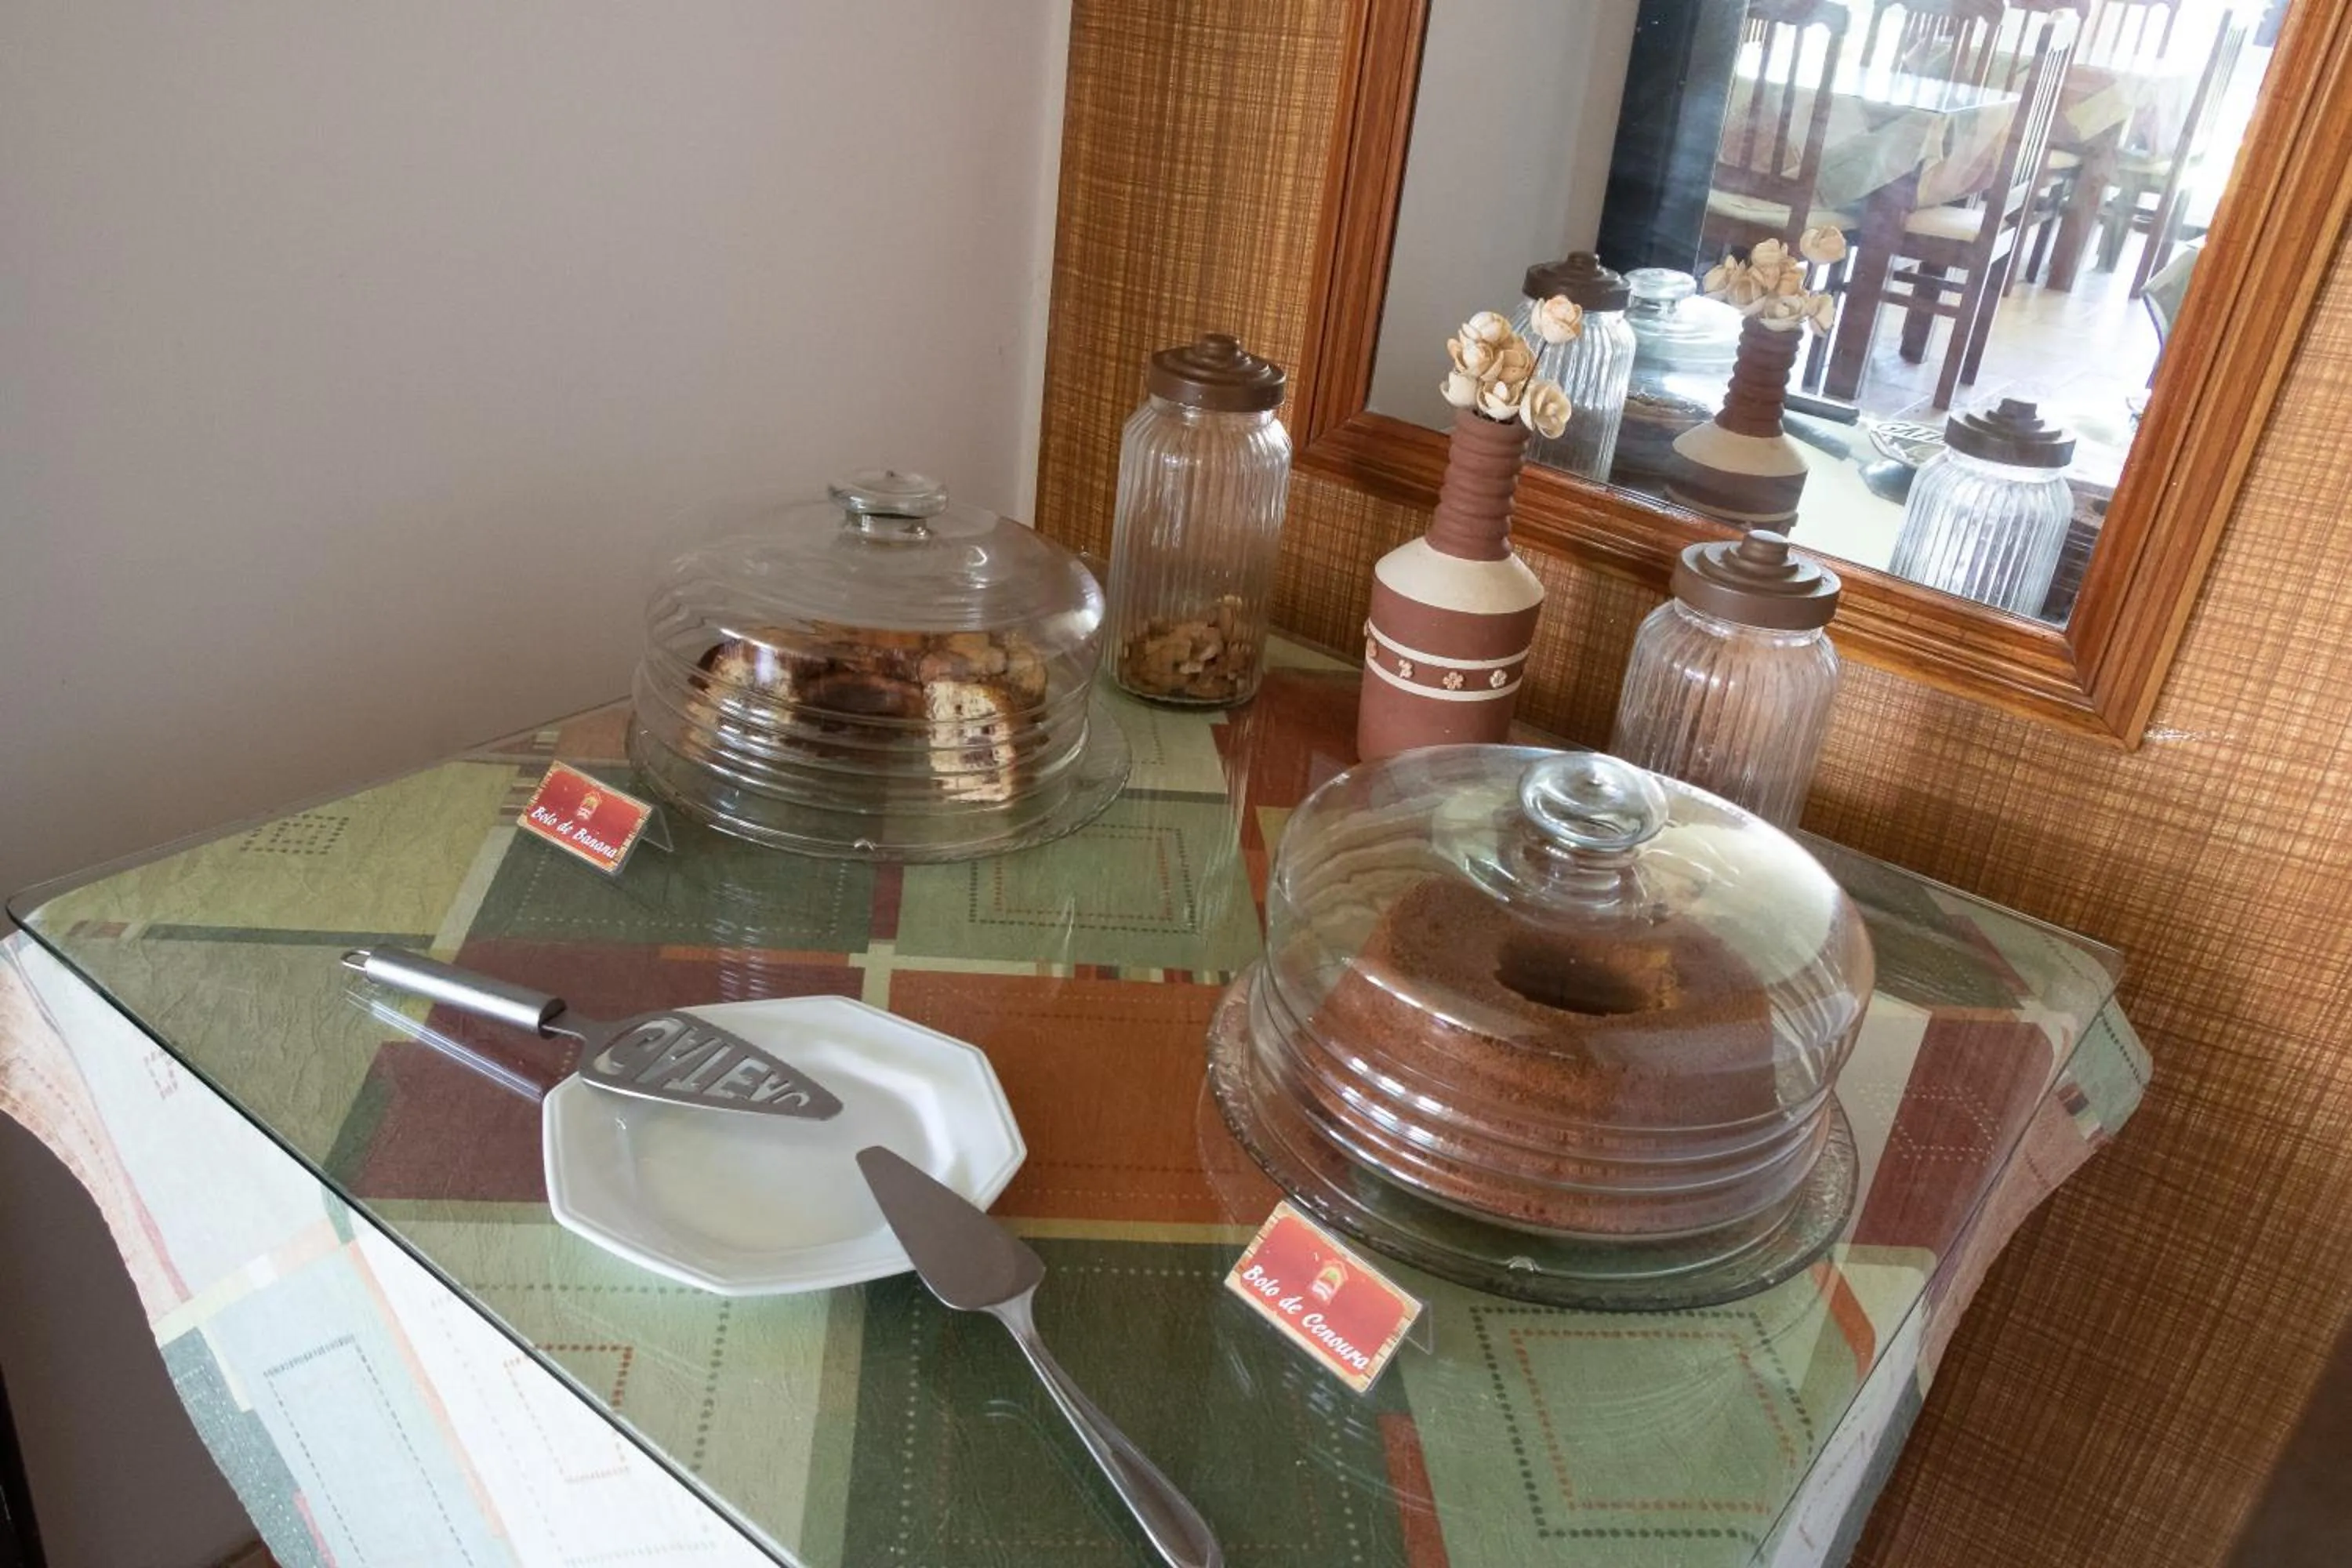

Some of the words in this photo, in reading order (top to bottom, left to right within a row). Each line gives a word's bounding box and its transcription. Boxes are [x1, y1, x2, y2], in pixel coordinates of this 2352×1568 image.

[531, 806, 557, 826] Bolo
[557, 819, 574, 835] de
[572, 828, 617, 858] Banana
[1242, 1265, 1281, 1297] Bolo
[1278, 1296, 1304, 1315] de
[1301, 1312, 1370, 1370] Cenoura
